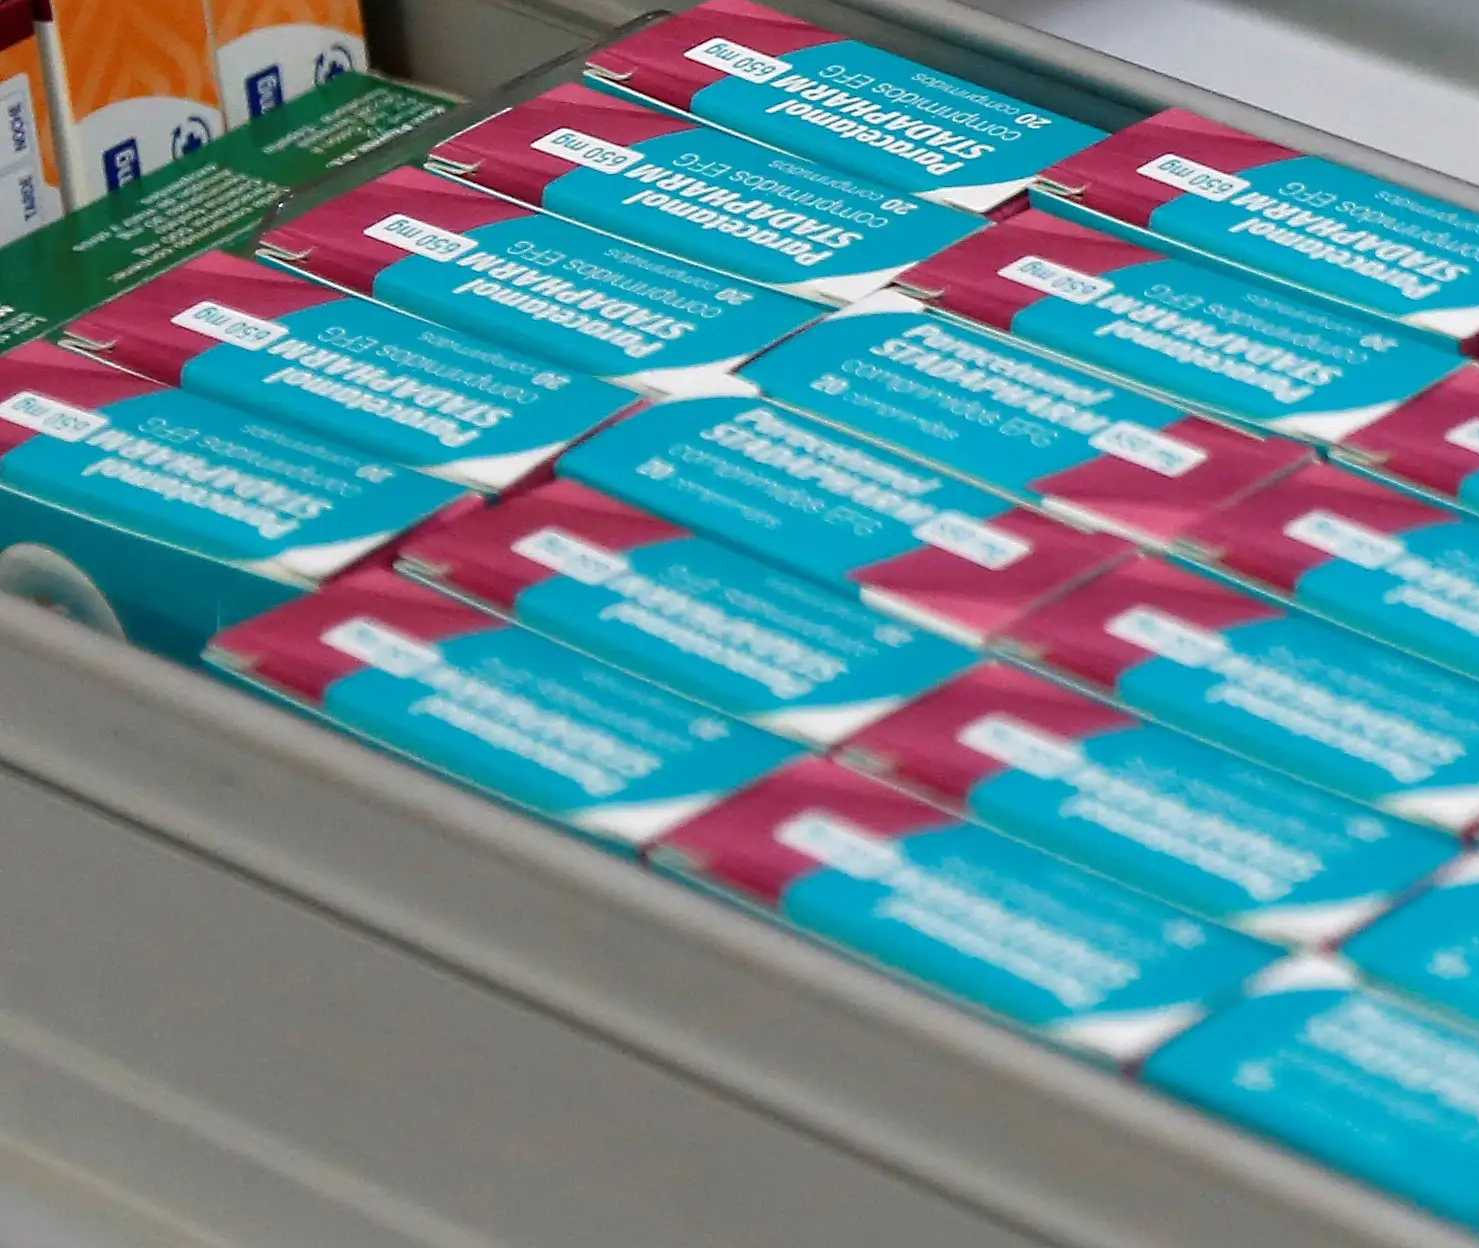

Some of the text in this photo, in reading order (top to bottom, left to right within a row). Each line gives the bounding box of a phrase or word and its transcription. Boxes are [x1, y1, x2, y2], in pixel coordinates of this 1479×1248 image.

[703, 42, 776, 77] 650 mg
[765, 97, 966, 177] Paracetamol
[774, 73, 997, 160] STADAPHARM
[817, 64, 1021, 142] comprimidos EFG
[911, 71, 1053, 131] 20 comprimidos
[551, 132, 629, 167] 650 mg
[768, 159, 920, 217] 20 comprimidos
[1156, 157, 1235, 194] 650 mg
[621, 188, 834, 268] Paracetamol
[623, 162, 864, 250] STADAPHARM
[672, 151, 889, 230] comprimidos EFG
[1277, 180, 1339, 209] EFG
[384, 218, 462, 254] 650 mg
[1227, 216, 1441, 301] Paracetamol
[1230, 190, 1472, 283] STADAPHARM
[451, 277, 667, 360] Paracetamol
[455, 250, 697, 342] STADAPHARM
[506, 239, 723, 320] comprimidos EFG
[262, 365, 482, 449] Paracetamol
[268, 338, 514, 430] STADAPHARM
